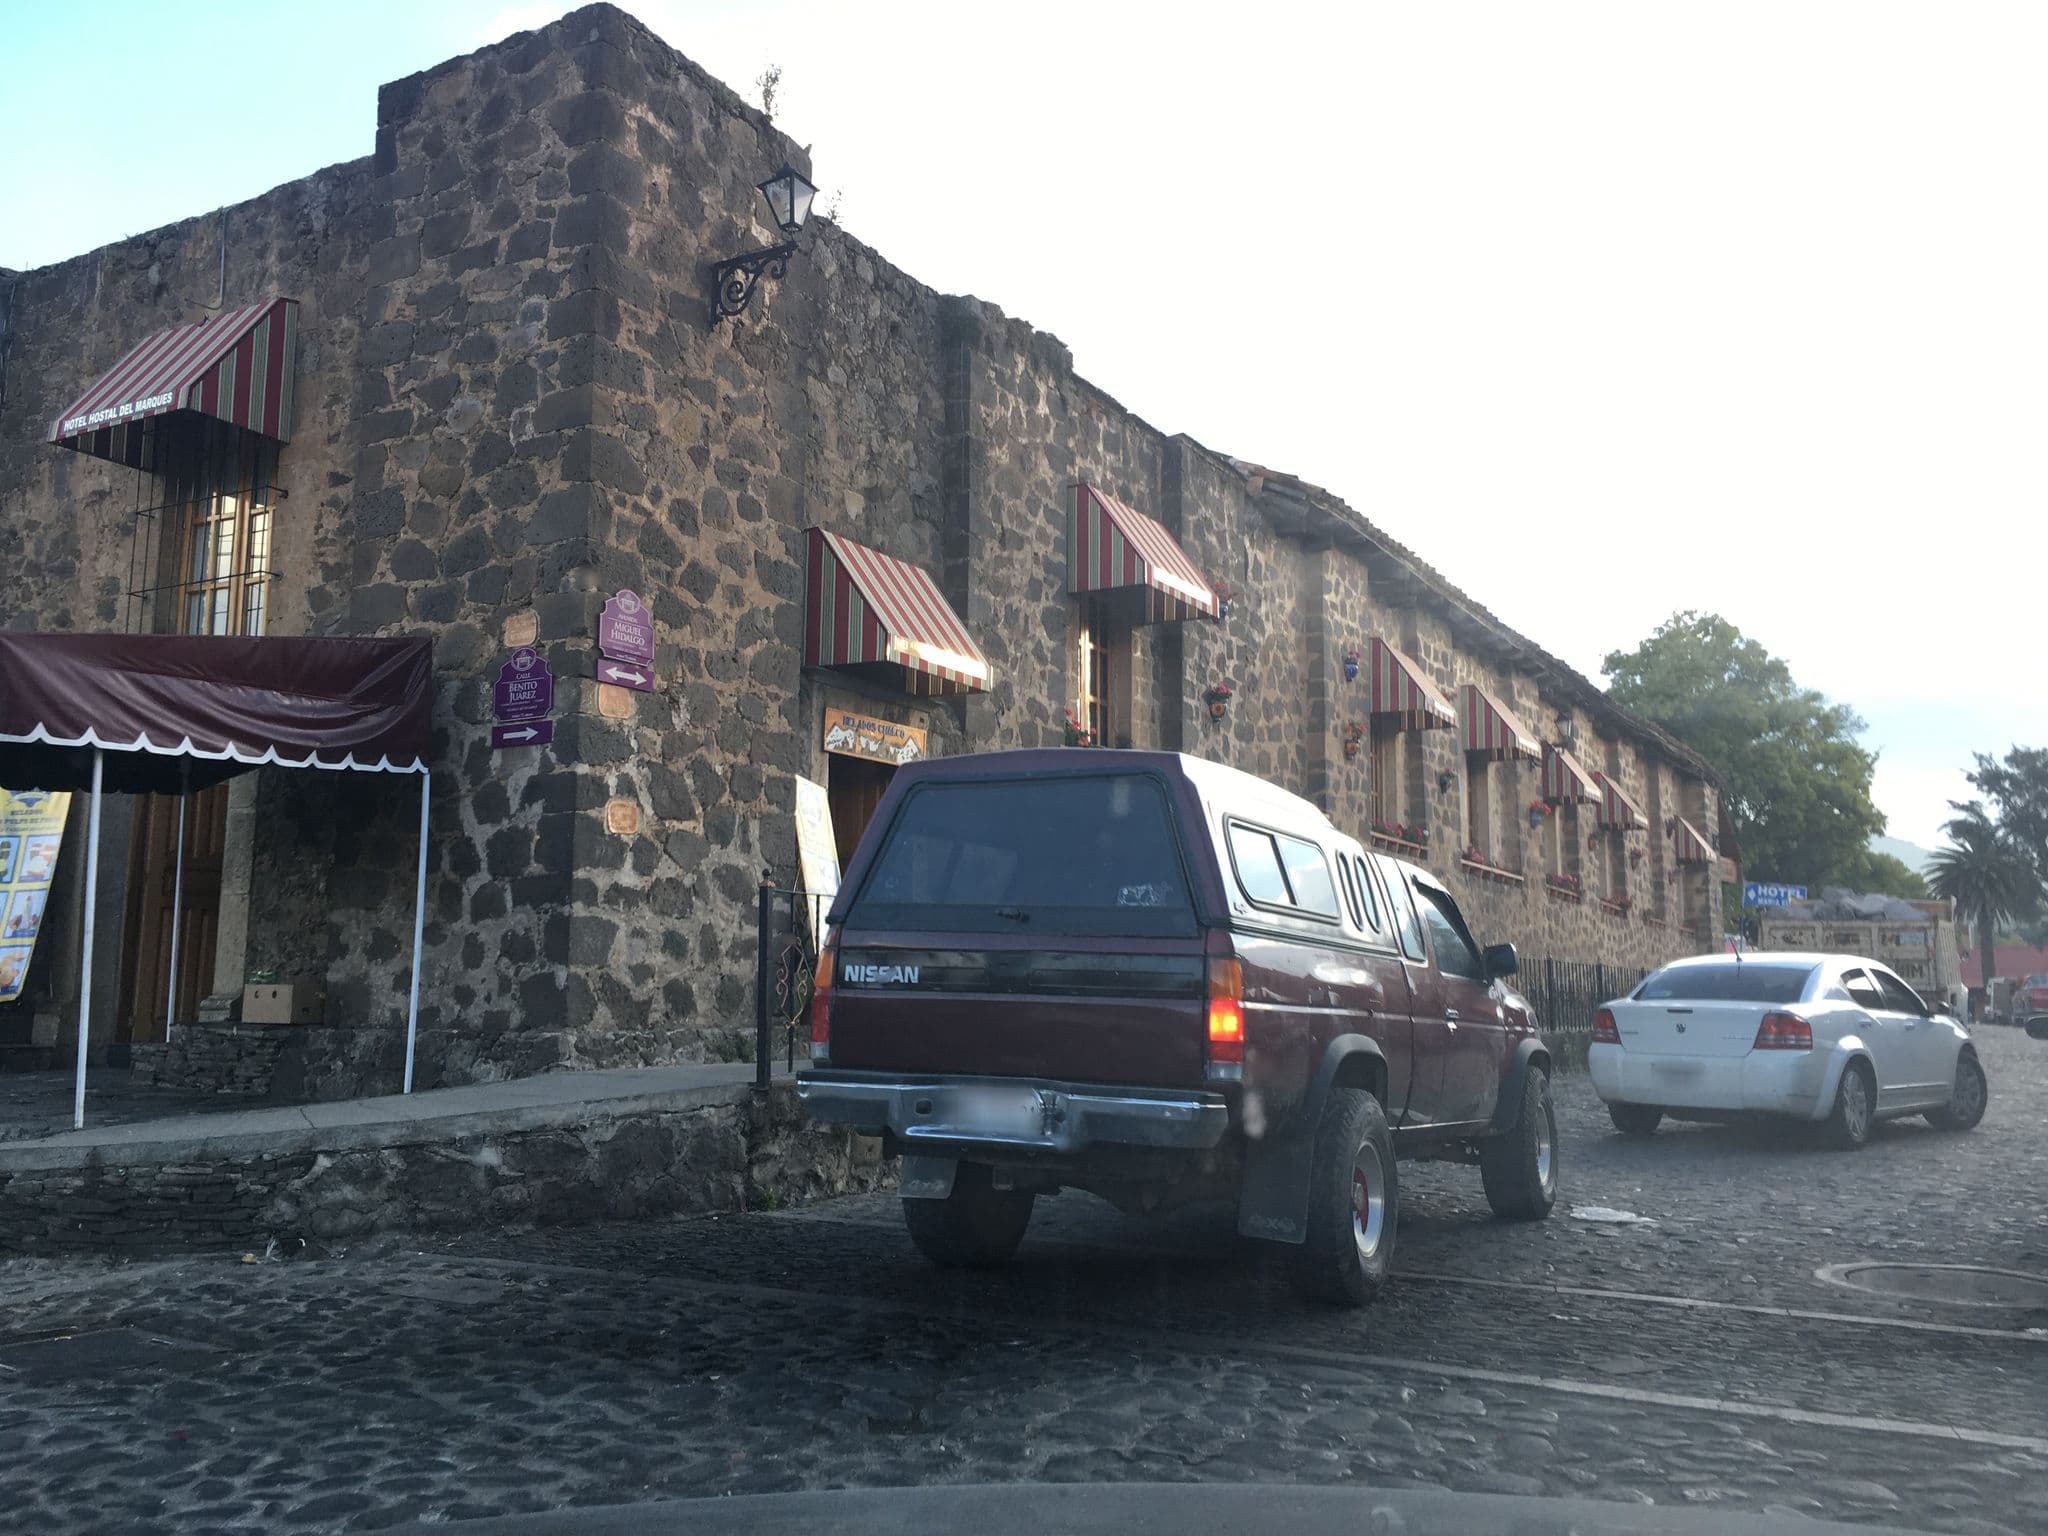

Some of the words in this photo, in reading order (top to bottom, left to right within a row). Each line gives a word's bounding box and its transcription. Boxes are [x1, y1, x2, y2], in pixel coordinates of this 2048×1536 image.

[64, 416, 87, 432] HOTEL
[88, 408, 118, 424] HOSTAL
[119, 403, 134, 417] DEL
[135, 392, 173, 411] MARQUES
[614, 621, 642, 637] MIGUEL
[611, 629, 645, 646] HIDALGO
[509, 681, 538, 692] BENITO
[1757, 884, 1804, 899] HOTEL
